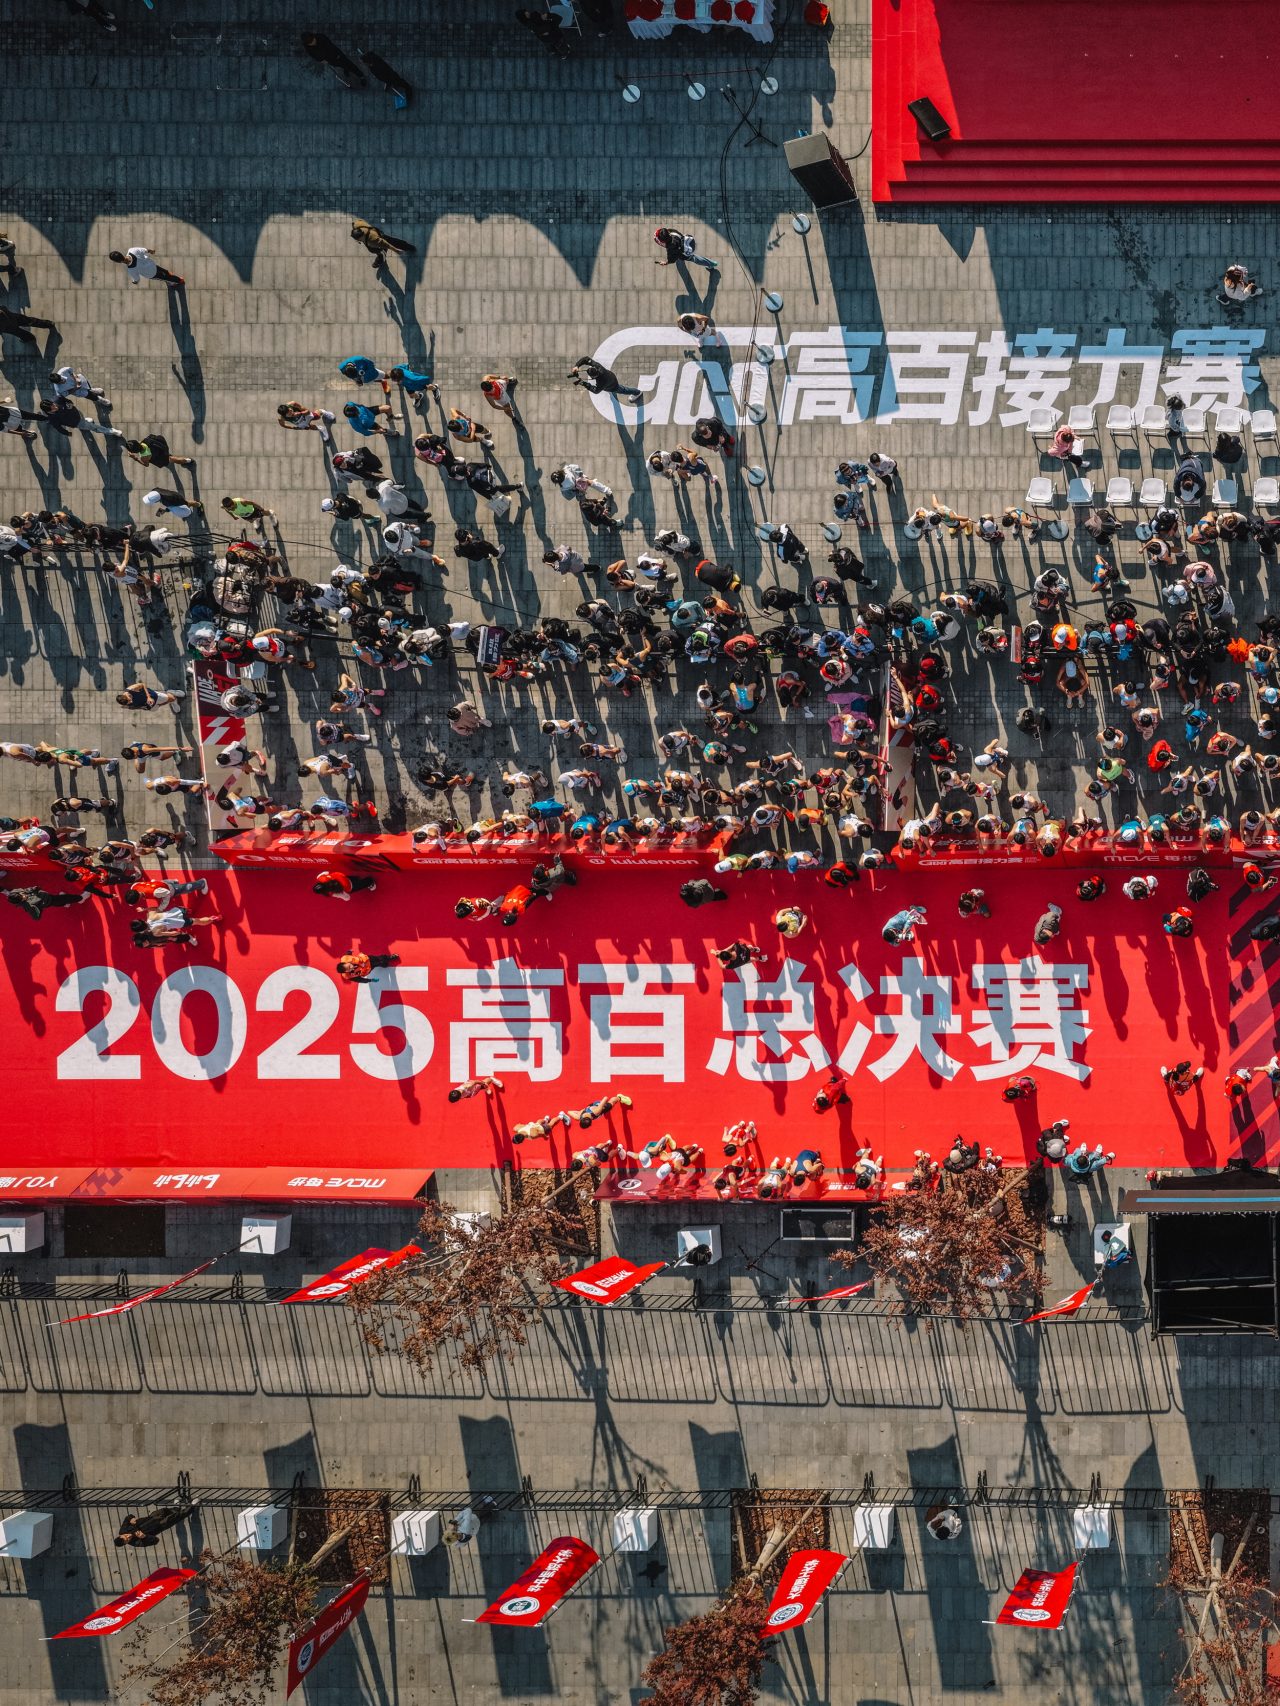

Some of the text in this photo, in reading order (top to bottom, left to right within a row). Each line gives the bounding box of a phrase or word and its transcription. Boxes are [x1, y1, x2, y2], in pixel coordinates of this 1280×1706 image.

[777, 325, 1268, 428] 高百接力赛
[55, 957, 1094, 1082] 2025高百总决赛
[153, 1173, 220, 1188] bilibili
[288, 1177, 387, 1188] MOVE 每步
